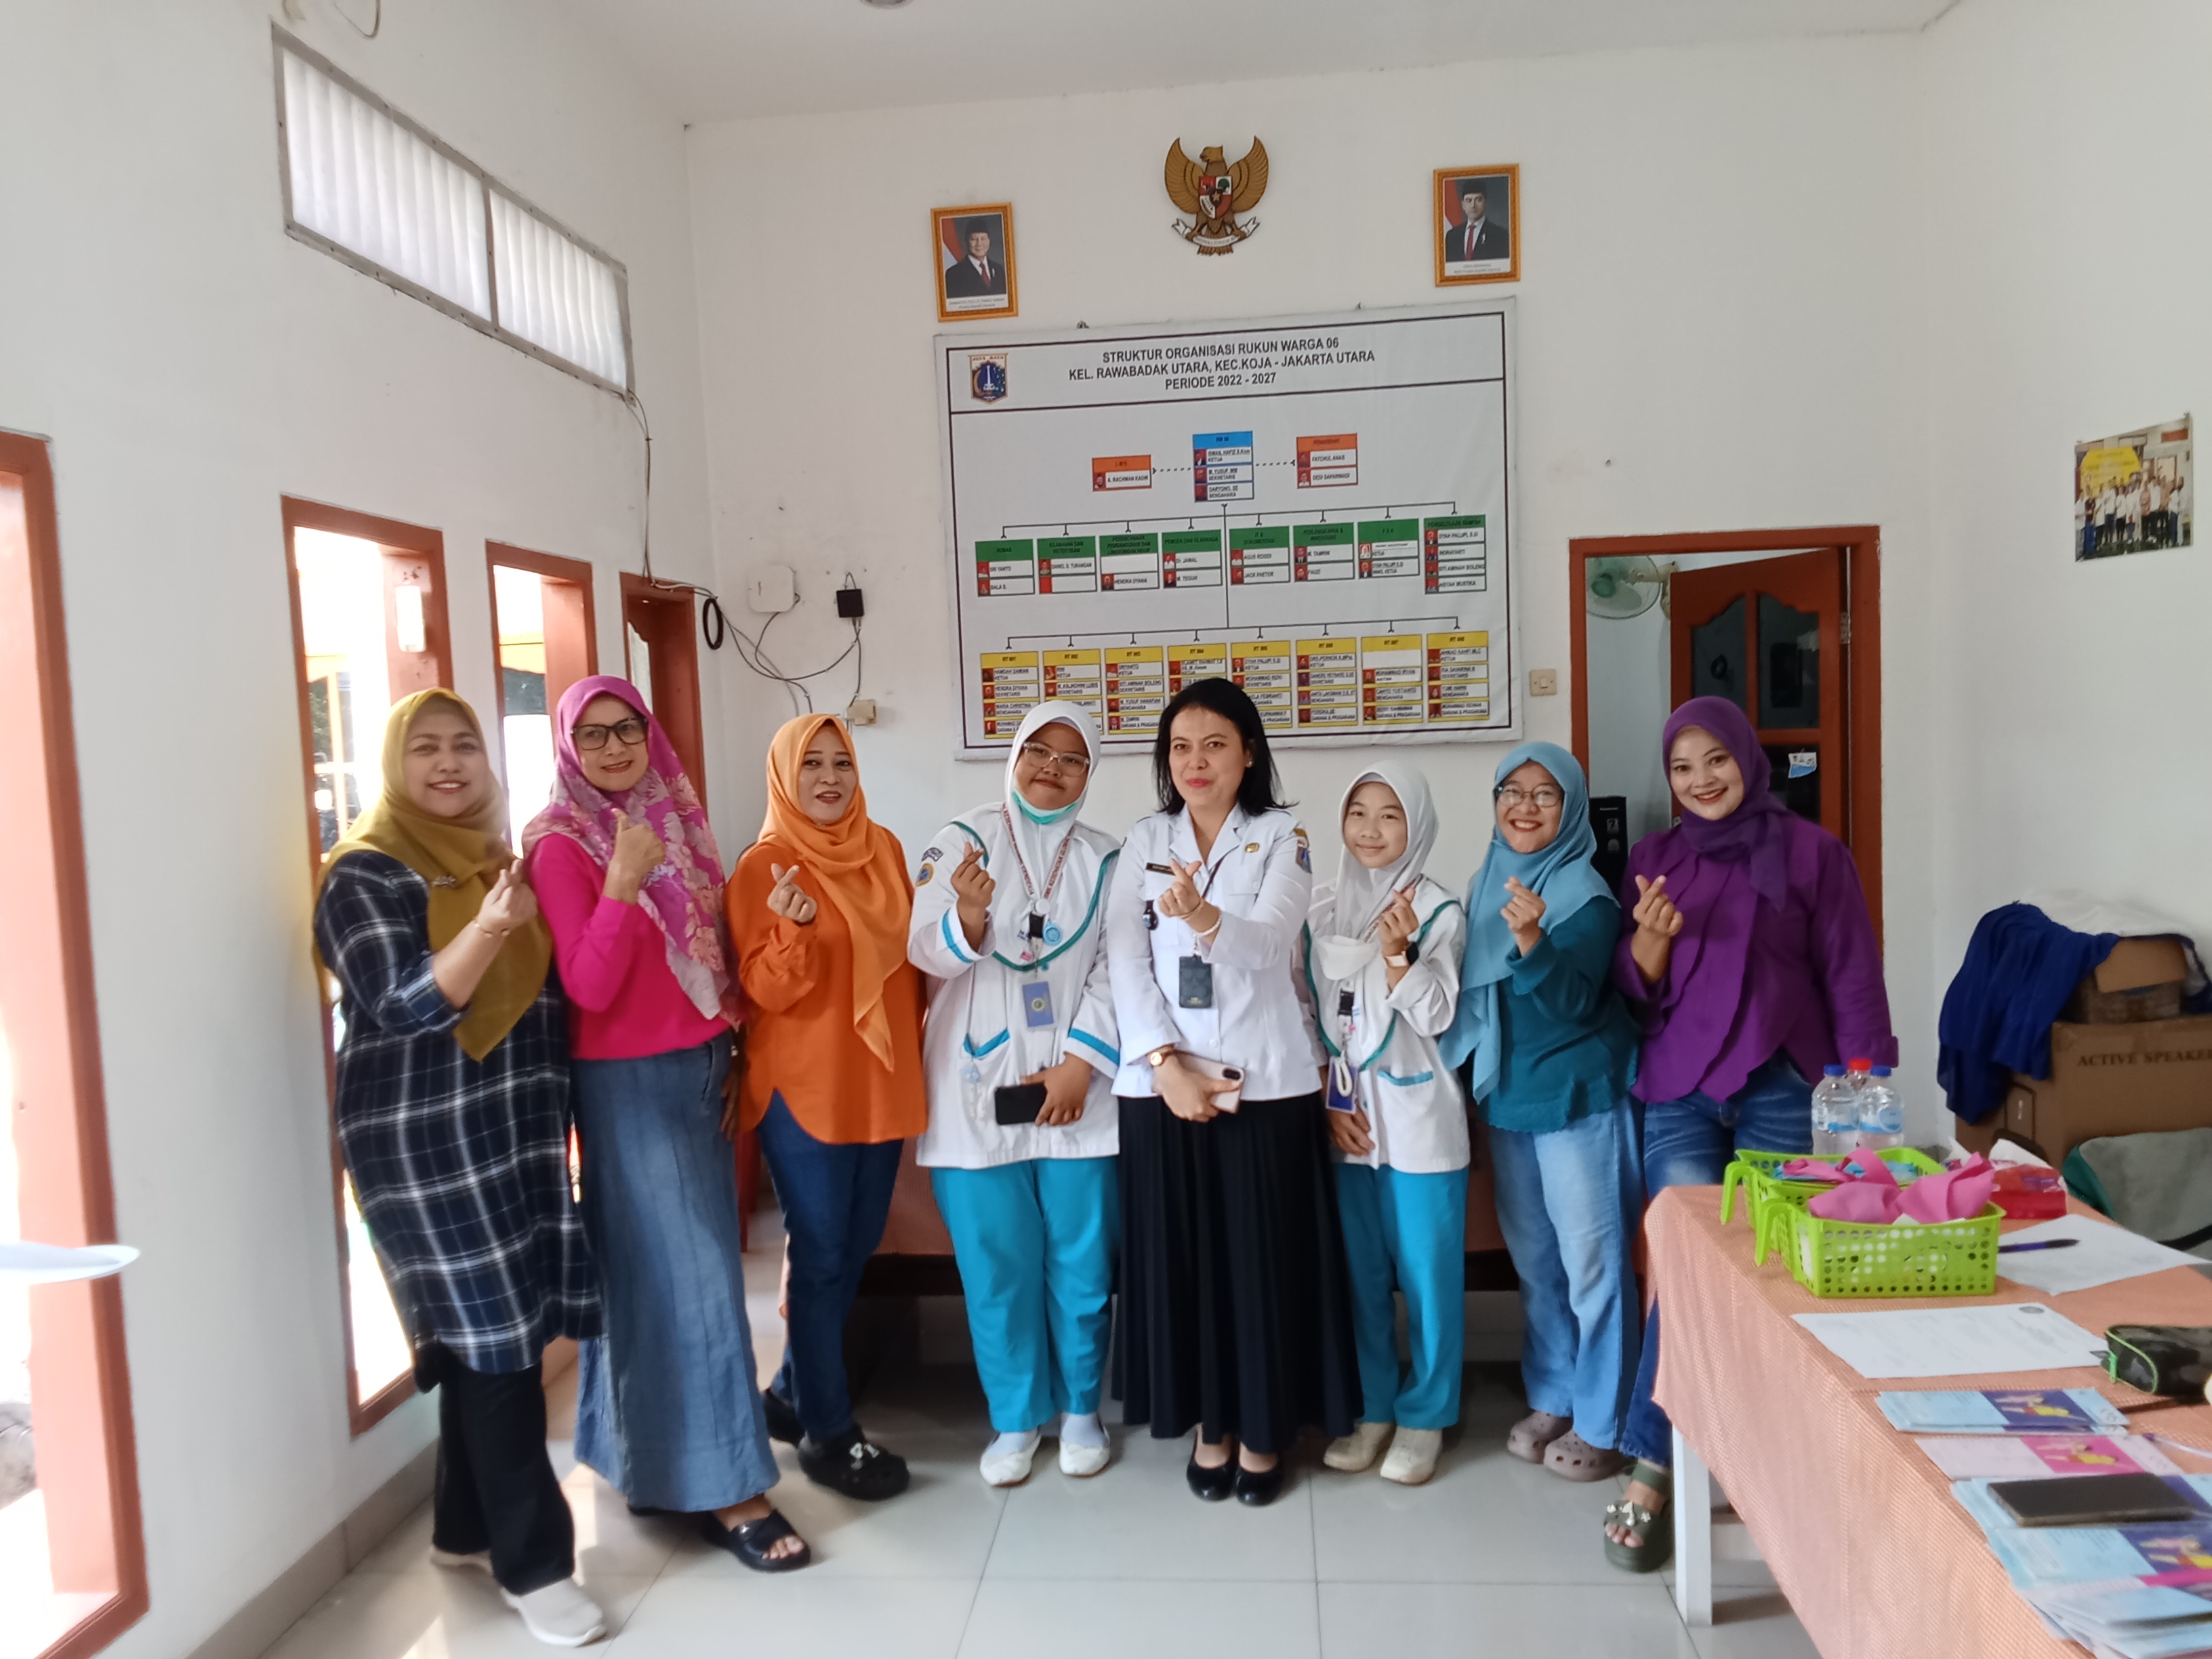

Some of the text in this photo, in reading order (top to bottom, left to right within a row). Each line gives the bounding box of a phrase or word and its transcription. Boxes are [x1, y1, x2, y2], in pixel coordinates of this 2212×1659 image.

[1103, 337, 1339, 364] STRUKTUR ORGANISASI RUKUN WARGA 06
[1069, 369, 1094, 381] KEL.
[1097, 362, 1168, 379] RAWABADAK
[1171, 361, 1212, 374] UTARA,
[1215, 356, 1272, 371] KEC.KOJA
[1281, 354, 1334, 367] JAKARTA
[1336, 350, 1375, 364] UTARA
[1165, 376, 1214, 390] PERIODE
[1217, 375, 1242, 386] 2022
[1252, 373, 1277, 384] 2027
[2077, 1053, 2137, 1067] ACTIVE
